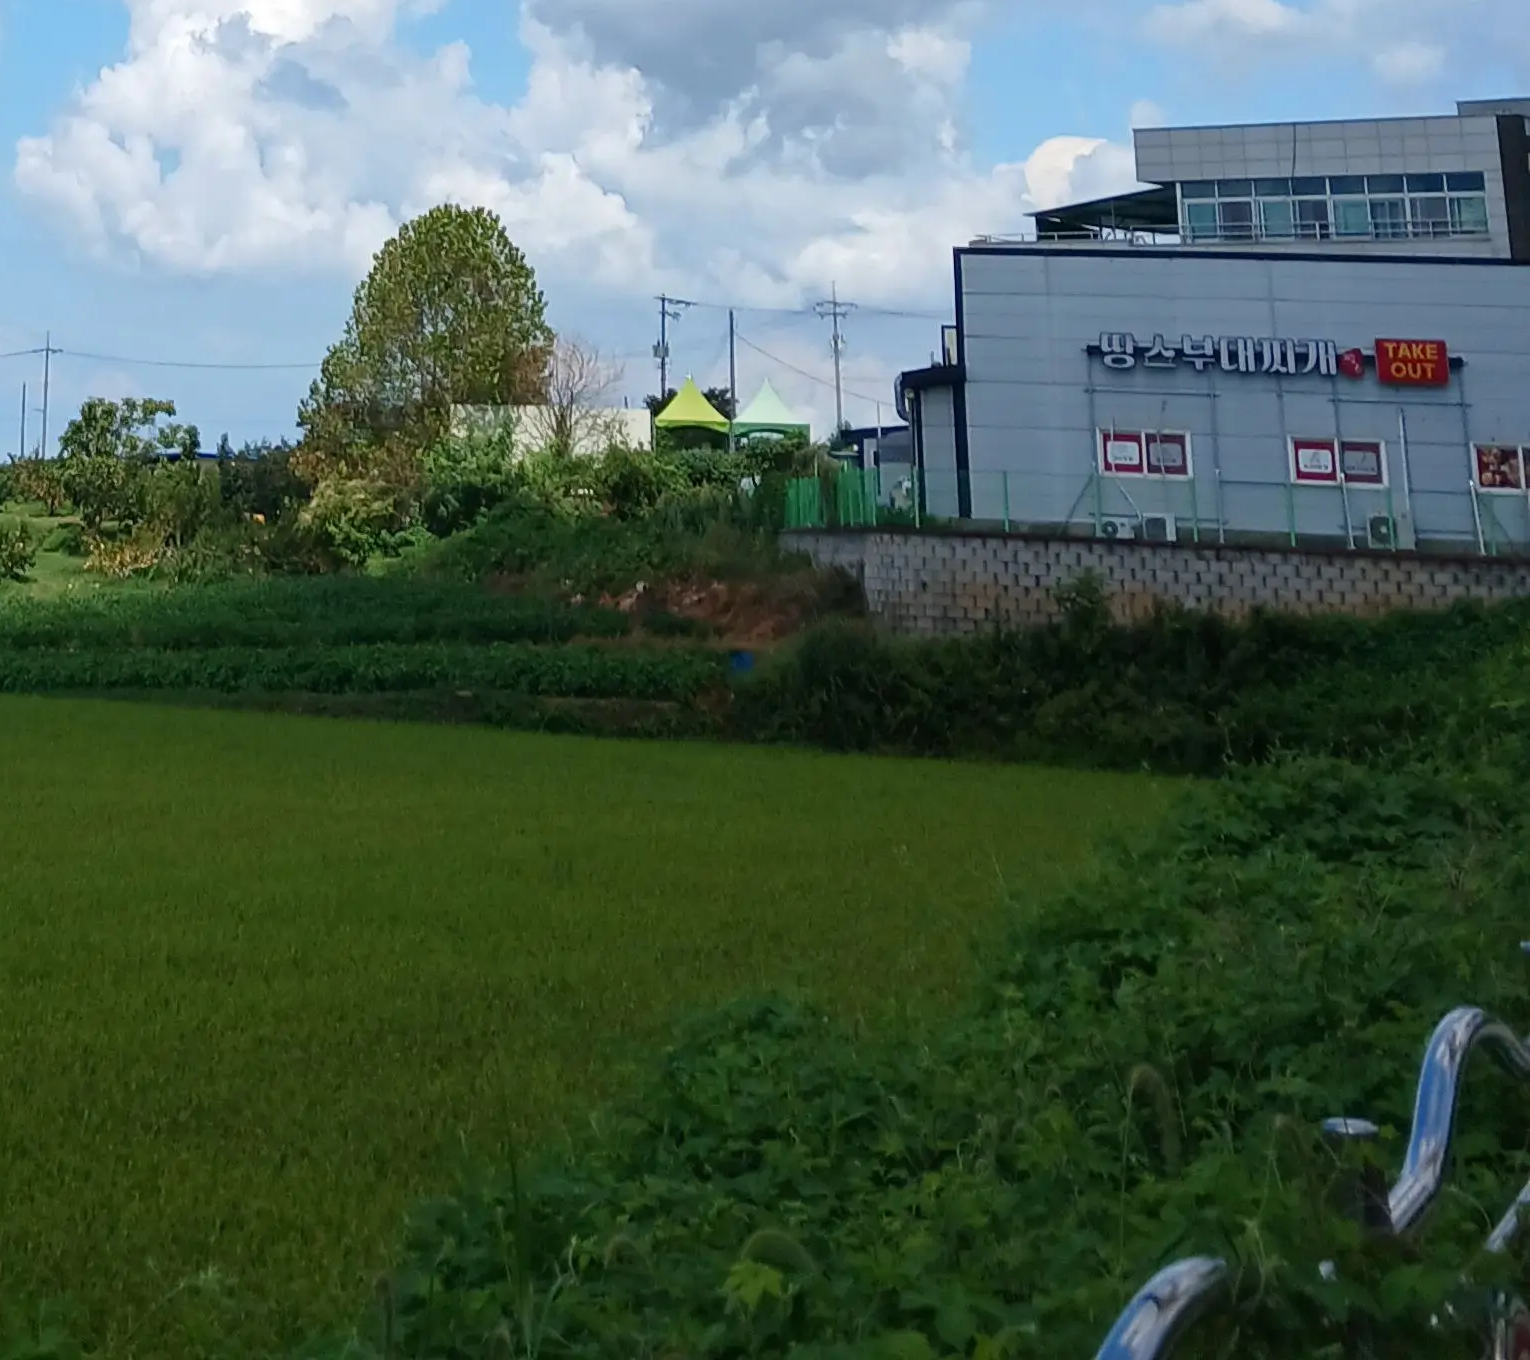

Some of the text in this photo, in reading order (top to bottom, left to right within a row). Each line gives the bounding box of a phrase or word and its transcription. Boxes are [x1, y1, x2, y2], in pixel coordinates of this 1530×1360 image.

[1100, 332, 1338, 376] 땅스부대찌개
[1383, 341, 1439, 360] TAKE
[1389, 361, 1436, 379] OUT
